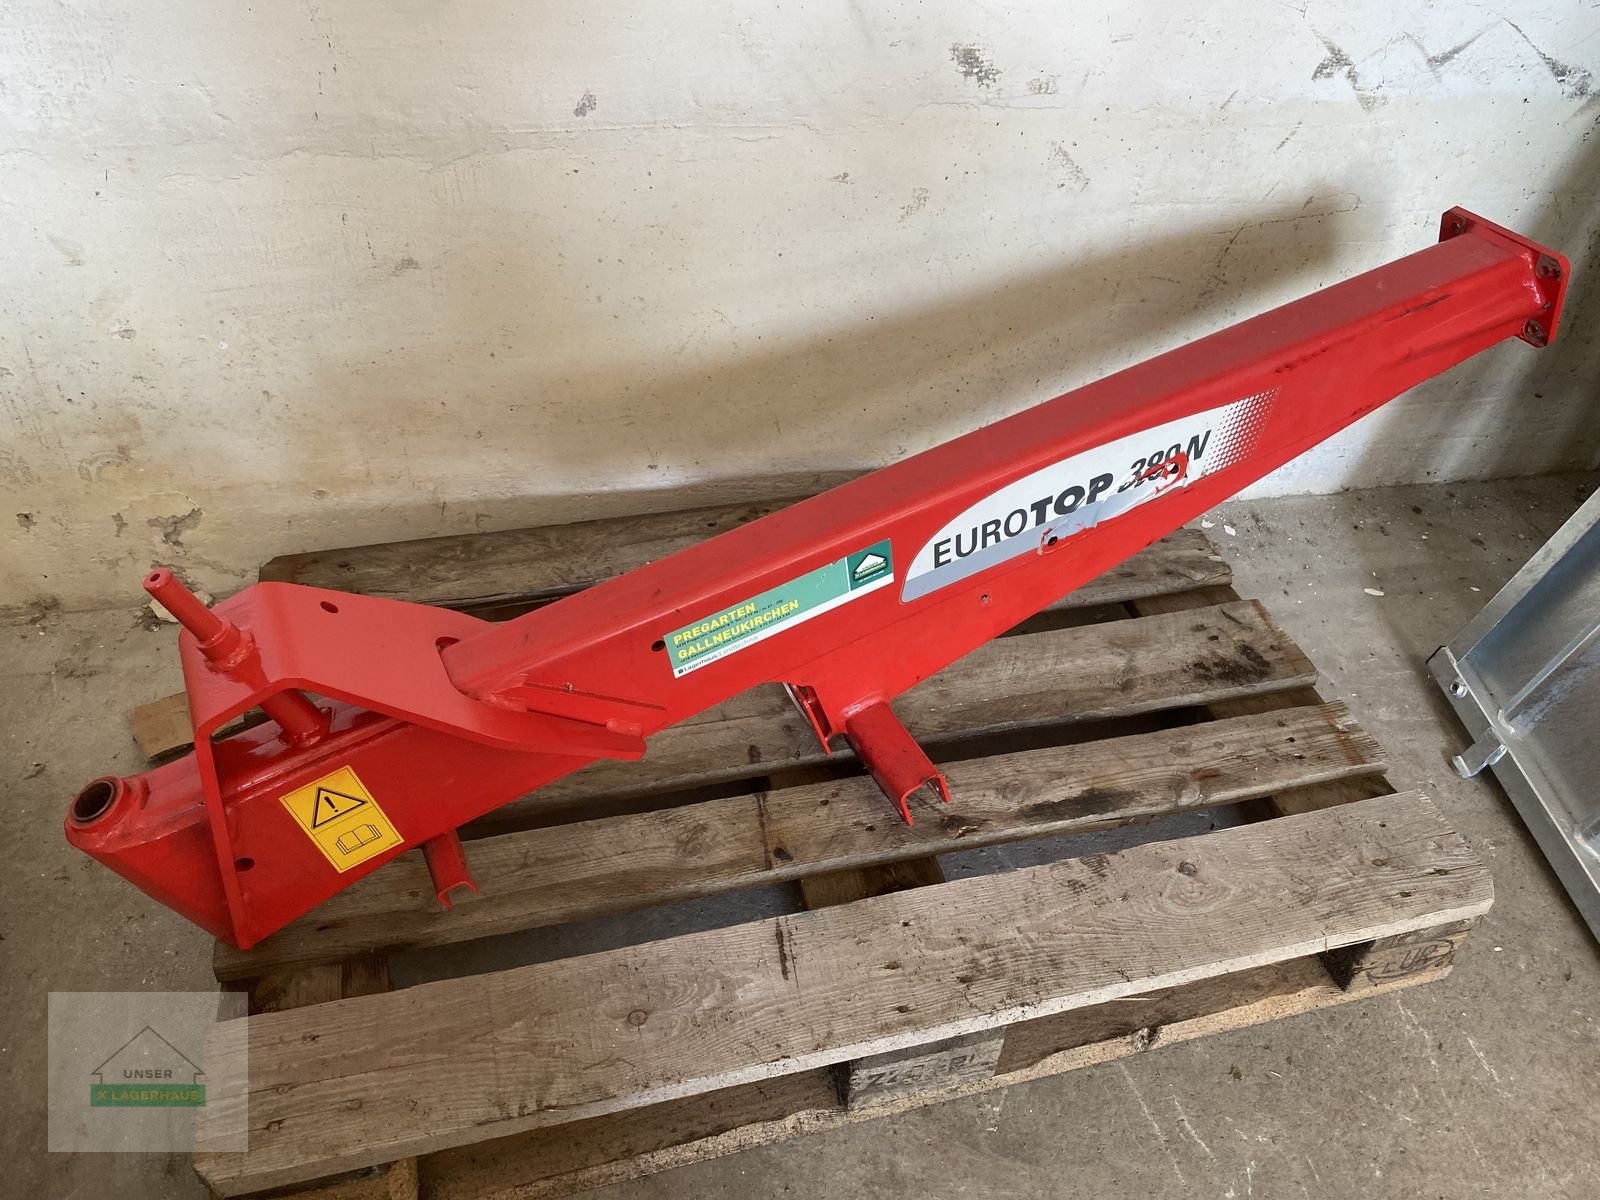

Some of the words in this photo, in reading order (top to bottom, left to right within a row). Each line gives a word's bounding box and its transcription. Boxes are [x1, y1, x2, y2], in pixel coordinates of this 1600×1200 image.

[933, 472, 1113, 568] EUROTOP
[673, 602, 756, 645] PREGARTEN
[678, 599, 799, 659] GALLNEUKIRCHEN
[683, 652, 718, 673] Lagerhaus
